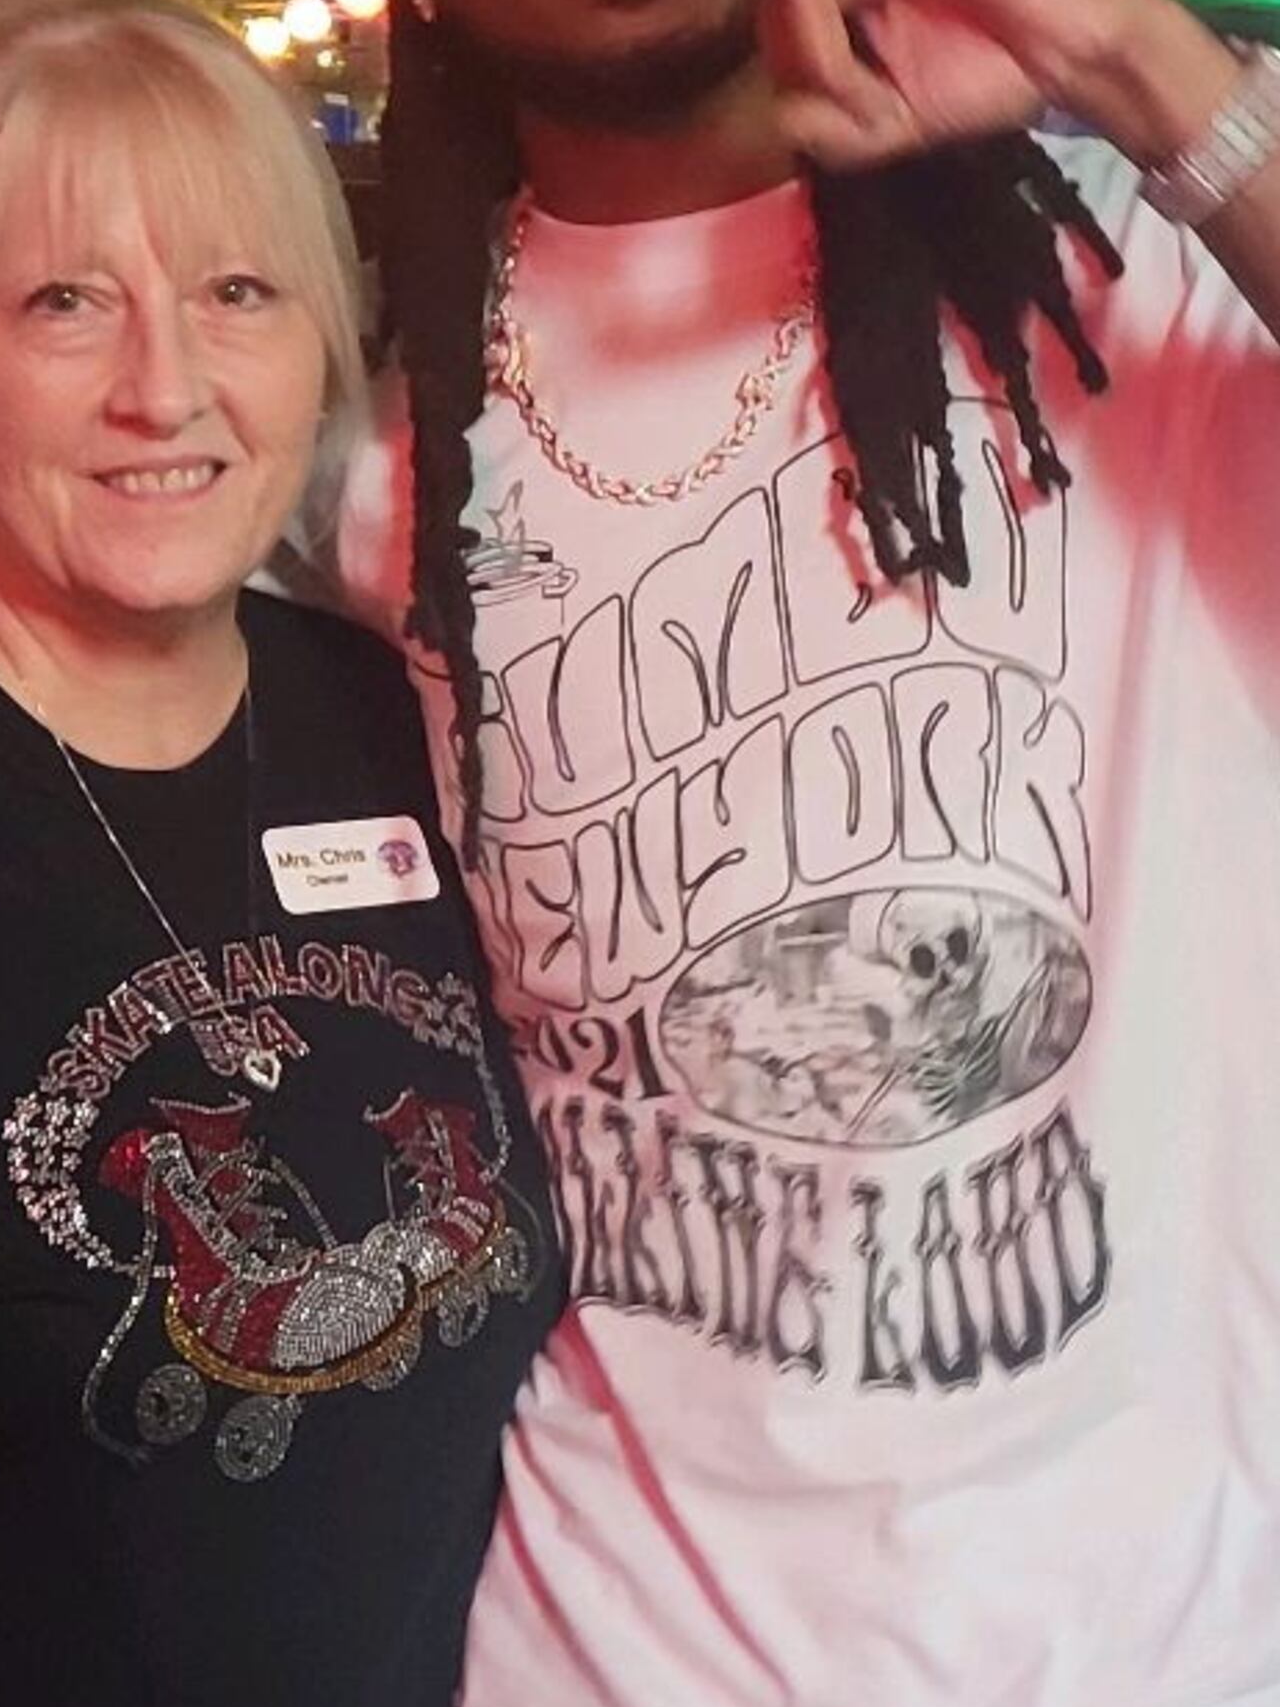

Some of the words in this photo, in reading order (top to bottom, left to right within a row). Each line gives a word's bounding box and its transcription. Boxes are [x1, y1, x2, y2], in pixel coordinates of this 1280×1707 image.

[276, 851, 314, 869] Mrs.
[319, 847, 366, 866] Chris
[676, 661, 1093, 952] YORK
[42, 946, 242, 1098] SKATE
[222, 934, 432, 1024] ALONG
